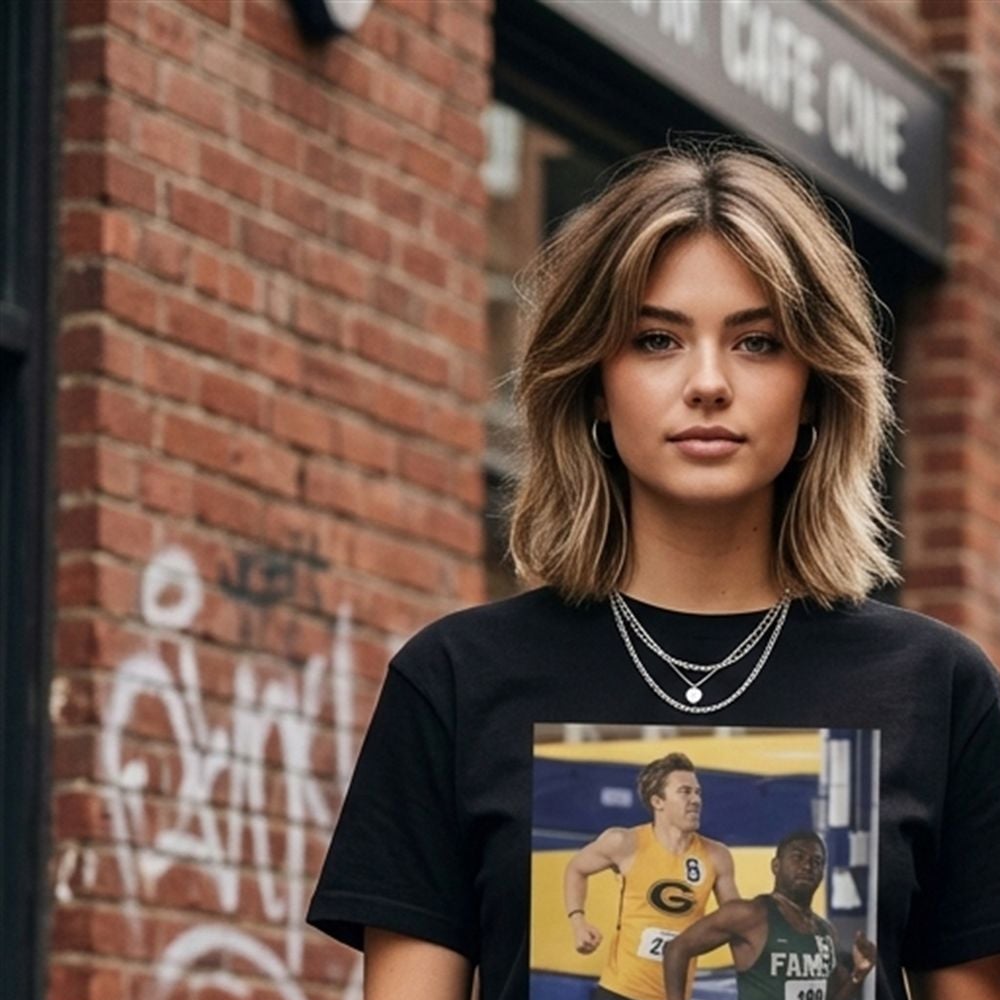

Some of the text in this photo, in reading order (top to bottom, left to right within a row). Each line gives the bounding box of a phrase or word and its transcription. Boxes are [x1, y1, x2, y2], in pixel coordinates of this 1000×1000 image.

[720, 0, 908, 192] CAFE ONE
[649, 881, 696, 915] G
